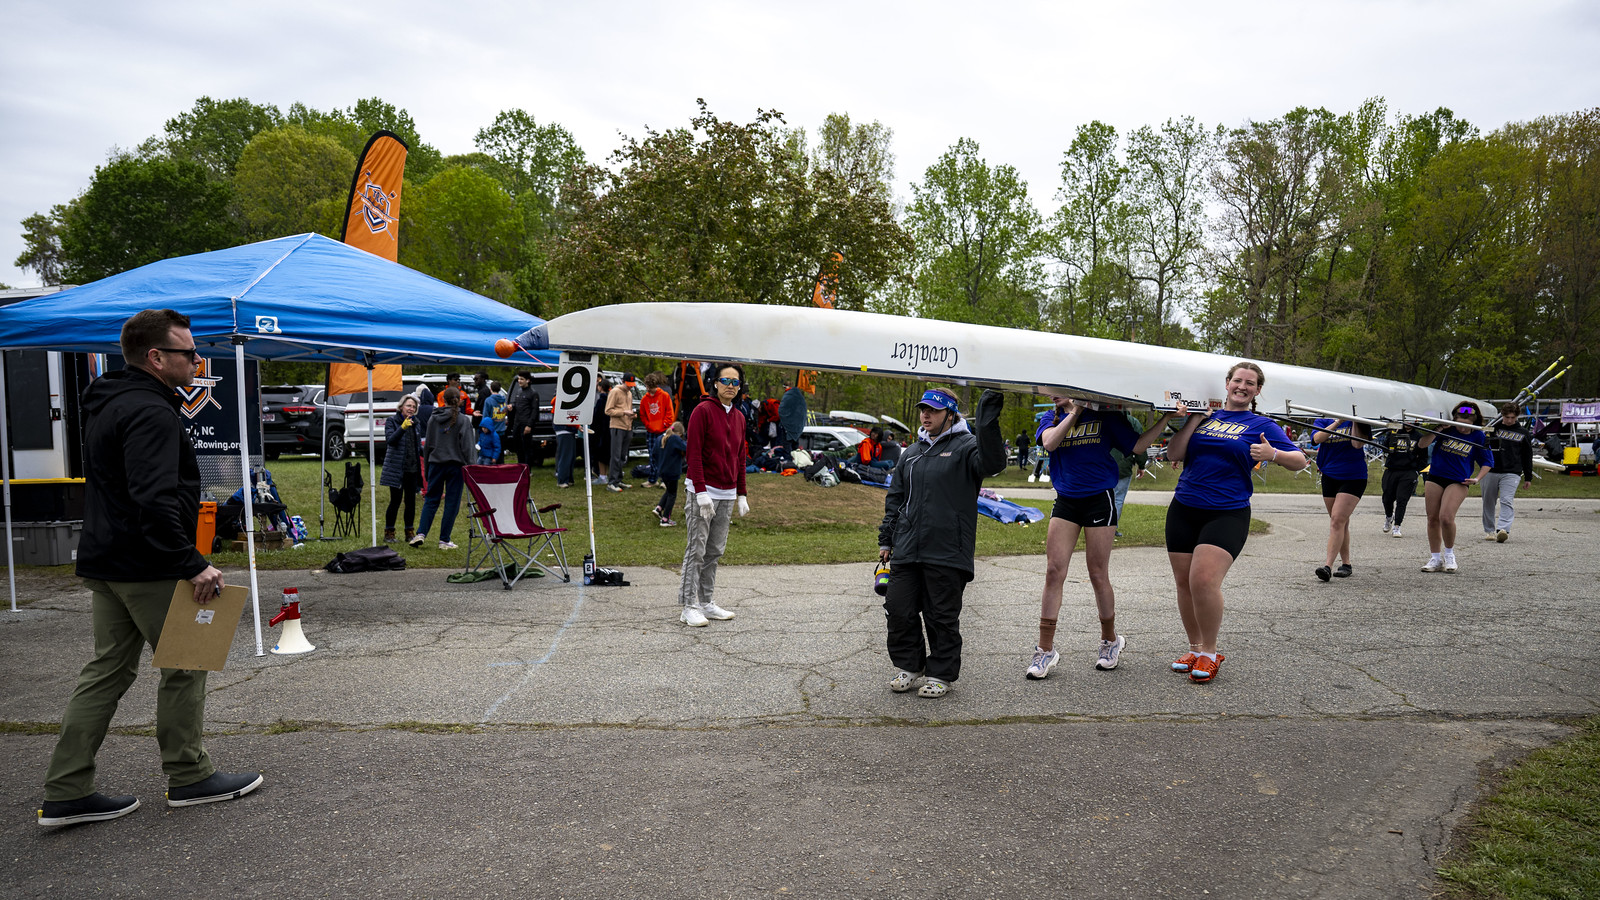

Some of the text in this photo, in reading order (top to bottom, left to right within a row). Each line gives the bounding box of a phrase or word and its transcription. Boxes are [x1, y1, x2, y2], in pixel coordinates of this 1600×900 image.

[890, 342, 958, 369] Cavalier
[560, 365, 591, 410] 9
[1170, 391, 1182, 400] USA
[1565, 406, 1596, 416] JMU
[201, 426, 215, 436] NC
[1065, 422, 1100, 439] MU
[1496, 429, 1526, 442] JMU
[1072, 438, 1101, 446] ROWING
[1442, 439, 1473, 454] JMU
